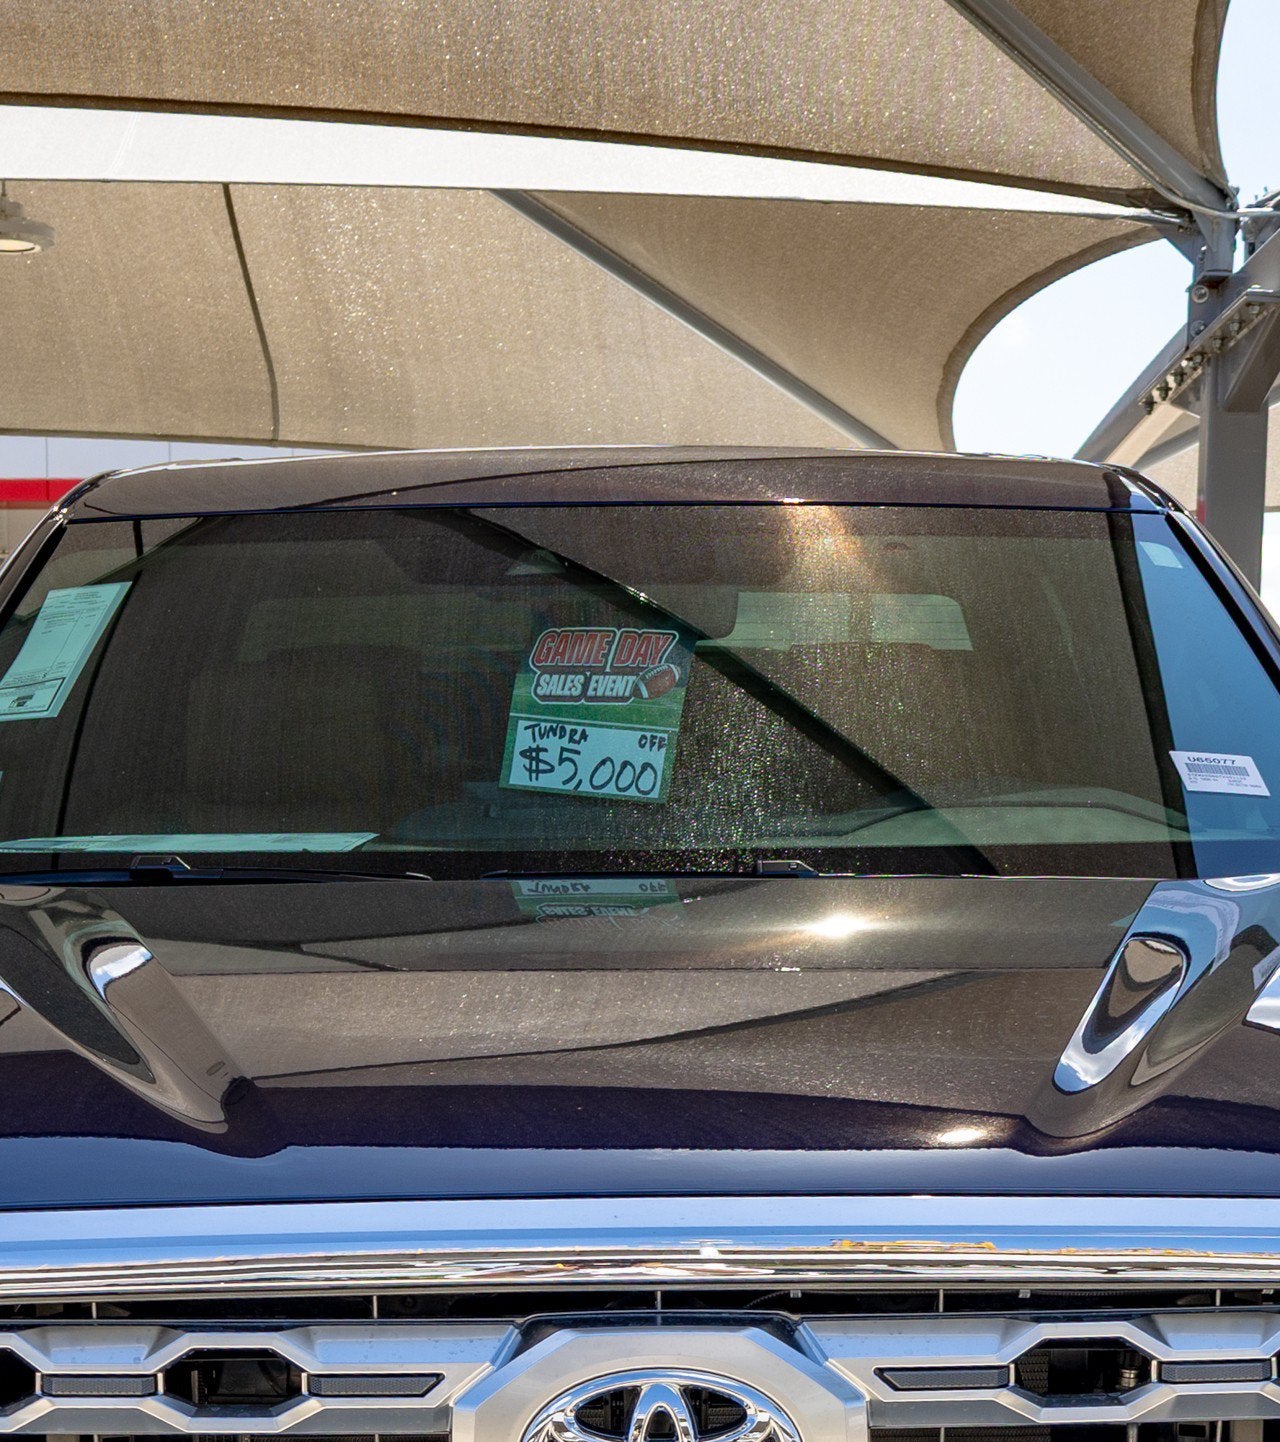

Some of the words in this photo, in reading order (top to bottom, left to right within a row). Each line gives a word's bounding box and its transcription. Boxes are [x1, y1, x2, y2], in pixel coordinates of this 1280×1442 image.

[534, 632, 612, 667] GAME
[613, 634, 673, 667] DAY
[537, 673, 585, 697] SALES
[587, 674, 637, 697] EVENT
[523, 723, 589, 746] TUNDRA
[637, 734, 667, 752] OFF
[519, 744, 658, 796] $5,000
